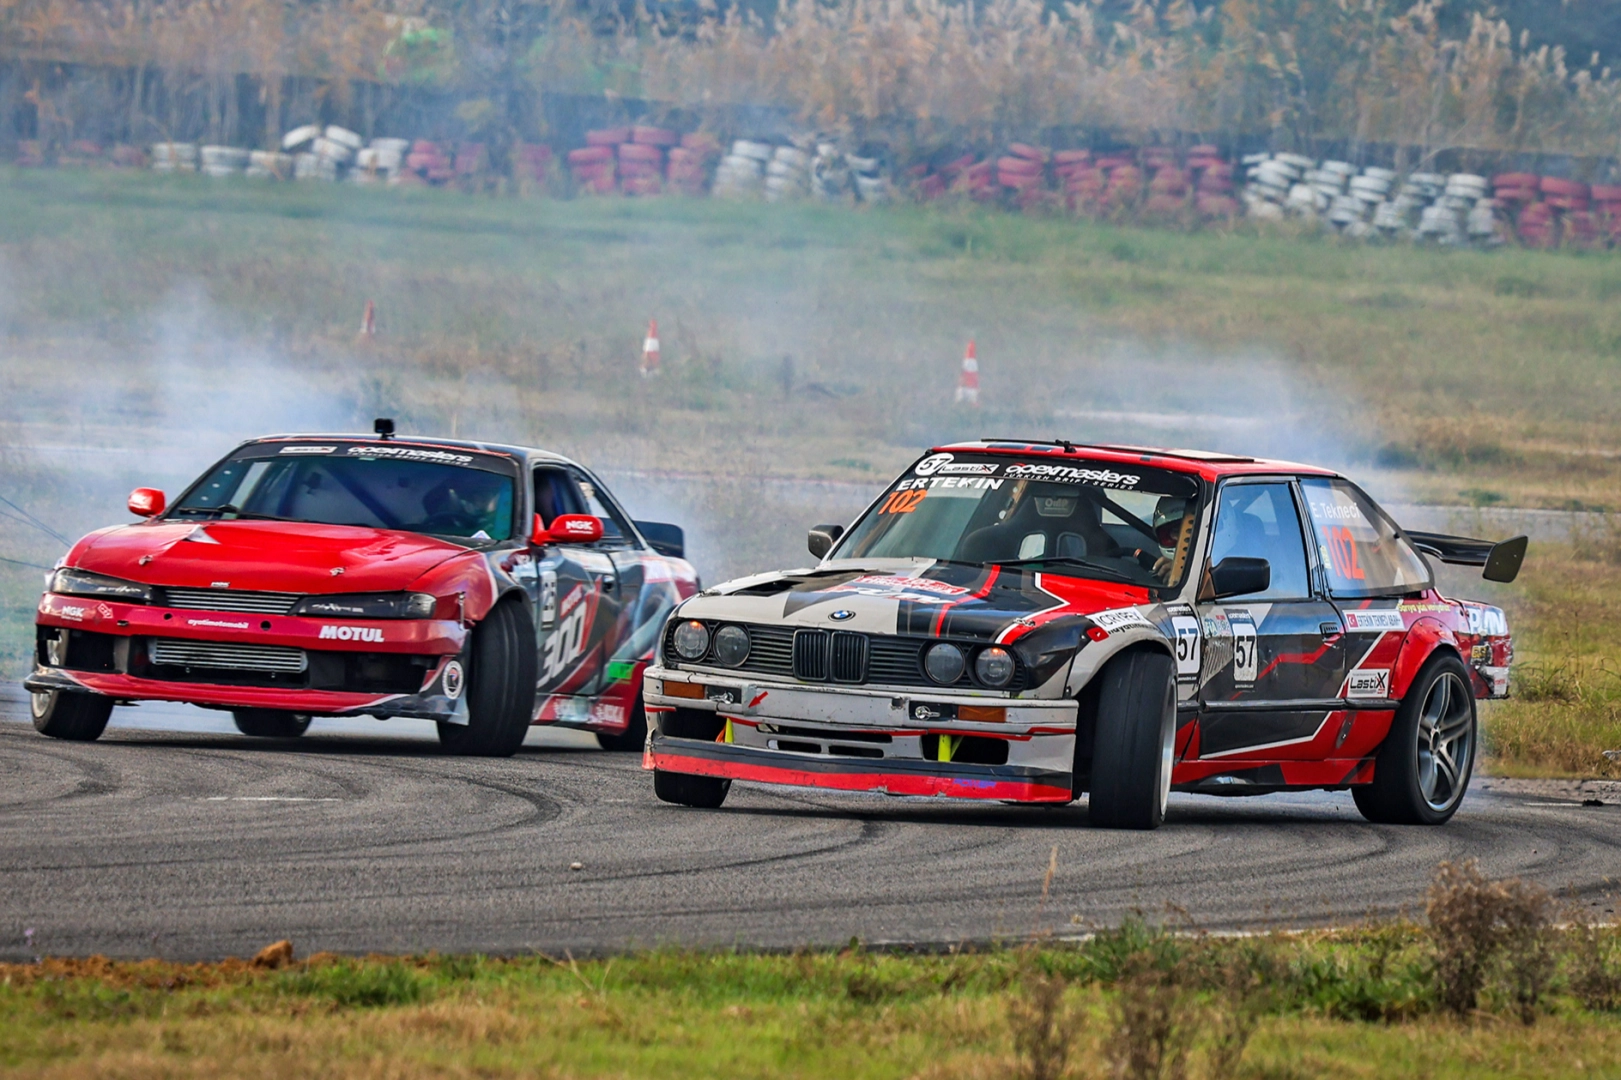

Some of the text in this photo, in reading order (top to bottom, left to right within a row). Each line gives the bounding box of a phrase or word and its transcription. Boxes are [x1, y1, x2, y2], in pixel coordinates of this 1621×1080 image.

[919, 458, 948, 470] 57
[942, 464, 993, 472] LastiX
[1005, 463, 1140, 485] apexmasters
[1093, 481, 1134, 490] SERIES
[878, 489, 928, 515] 102
[565, 521, 593, 531] NGK
[1321, 525, 1366, 580] 102
[62, 606, 84, 617] NGK
[319, 625, 385, 642] MOTUL
[1178, 627, 1200, 661] 57
[1236, 635, 1256, 669] 57
[1350, 672, 1387, 691] LastiX
